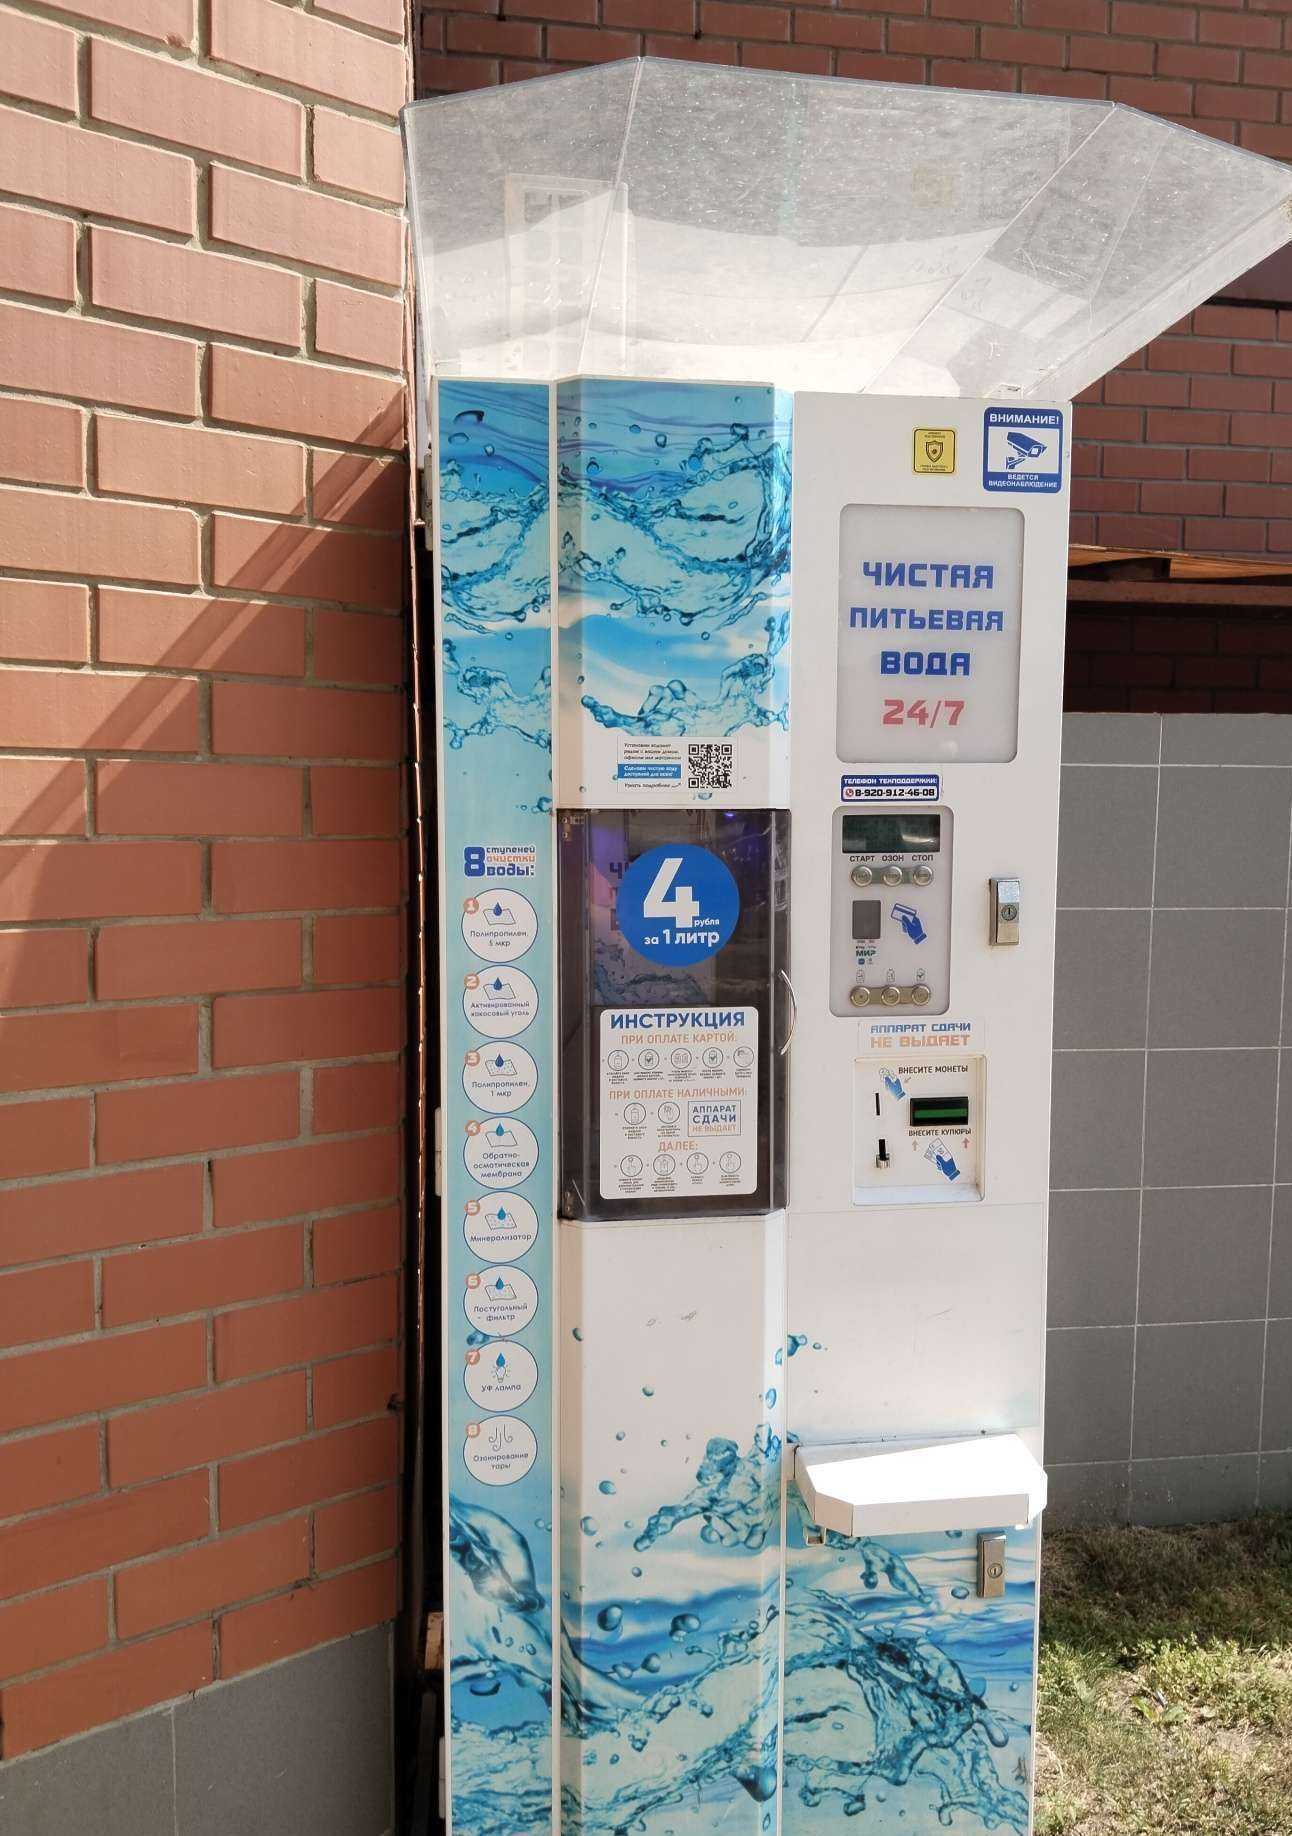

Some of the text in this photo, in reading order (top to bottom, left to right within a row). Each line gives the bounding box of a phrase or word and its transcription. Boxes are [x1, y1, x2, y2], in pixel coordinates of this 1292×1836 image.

[989, 413, 1059, 425] ВНИМАНИЕ!
[1007, 473, 1039, 481] ВЕДЕТСЯ
[988, 480, 1058, 488] ВИДЕОНАБЛЮДЕНИЕ
[863, 561, 994, 589] ЧИСТАЯ
[849, 607, 1003, 632] ПИТЬЕВАЯ
[880, 651, 971, 676] ВОДА
[882, 699, 966, 728] 24/7
[464, 846, 536, 877] 8 ступеней
[487, 854, 535, 862] очистки
[486, 863, 535, 876] воды:
[643, 857, 700, 928] 4
[644, 930, 720, 947] за 1 литр
[511, 1010, 530, 1018] уголь
[610, 1012, 745, 1029] ИНСТРУКЦИЯ
[870, 1023, 971, 1033] АППАРАТ СДАЧИ
[621, 1035, 644, 1044] ПРИ
[647, 1034, 689, 1044] ОПЛАТЕ
[870, 1035, 971, 1048] НЕ ВЫДАЕТ
[898, 1065, 968, 1074] ВНЕСИТЕ МОНЕТЫ
[608, 1090, 631, 1099] ПРИ
[633, 1089, 674, 1099] ОПЛАТЕ
[692, 1104, 737, 1113] АППАРАТ
[692, 1114, 737, 1125] СДАЧИ
[908, 1128, 972, 1137] ВНЕСИТЕ КУПЮРЫ
[657, 1140, 699, 1152] ДАЛЕЕ:
[482, 1151, 520, 1160] Обратно-
[473, 1161, 530, 1169] осмотическая
[480, 1170, 522, 1179] мембрана
[470, 1233, 532, 1243] Минерализатор
[474, 1303, 528, 1313] Постугольный
[486, 1313, 516, 1322] фильтр
[496, 1384, 521, 1392] лампа
[473, 1453, 529, 1462] Озонирование
[491, 1463, 511, 1471] тары
